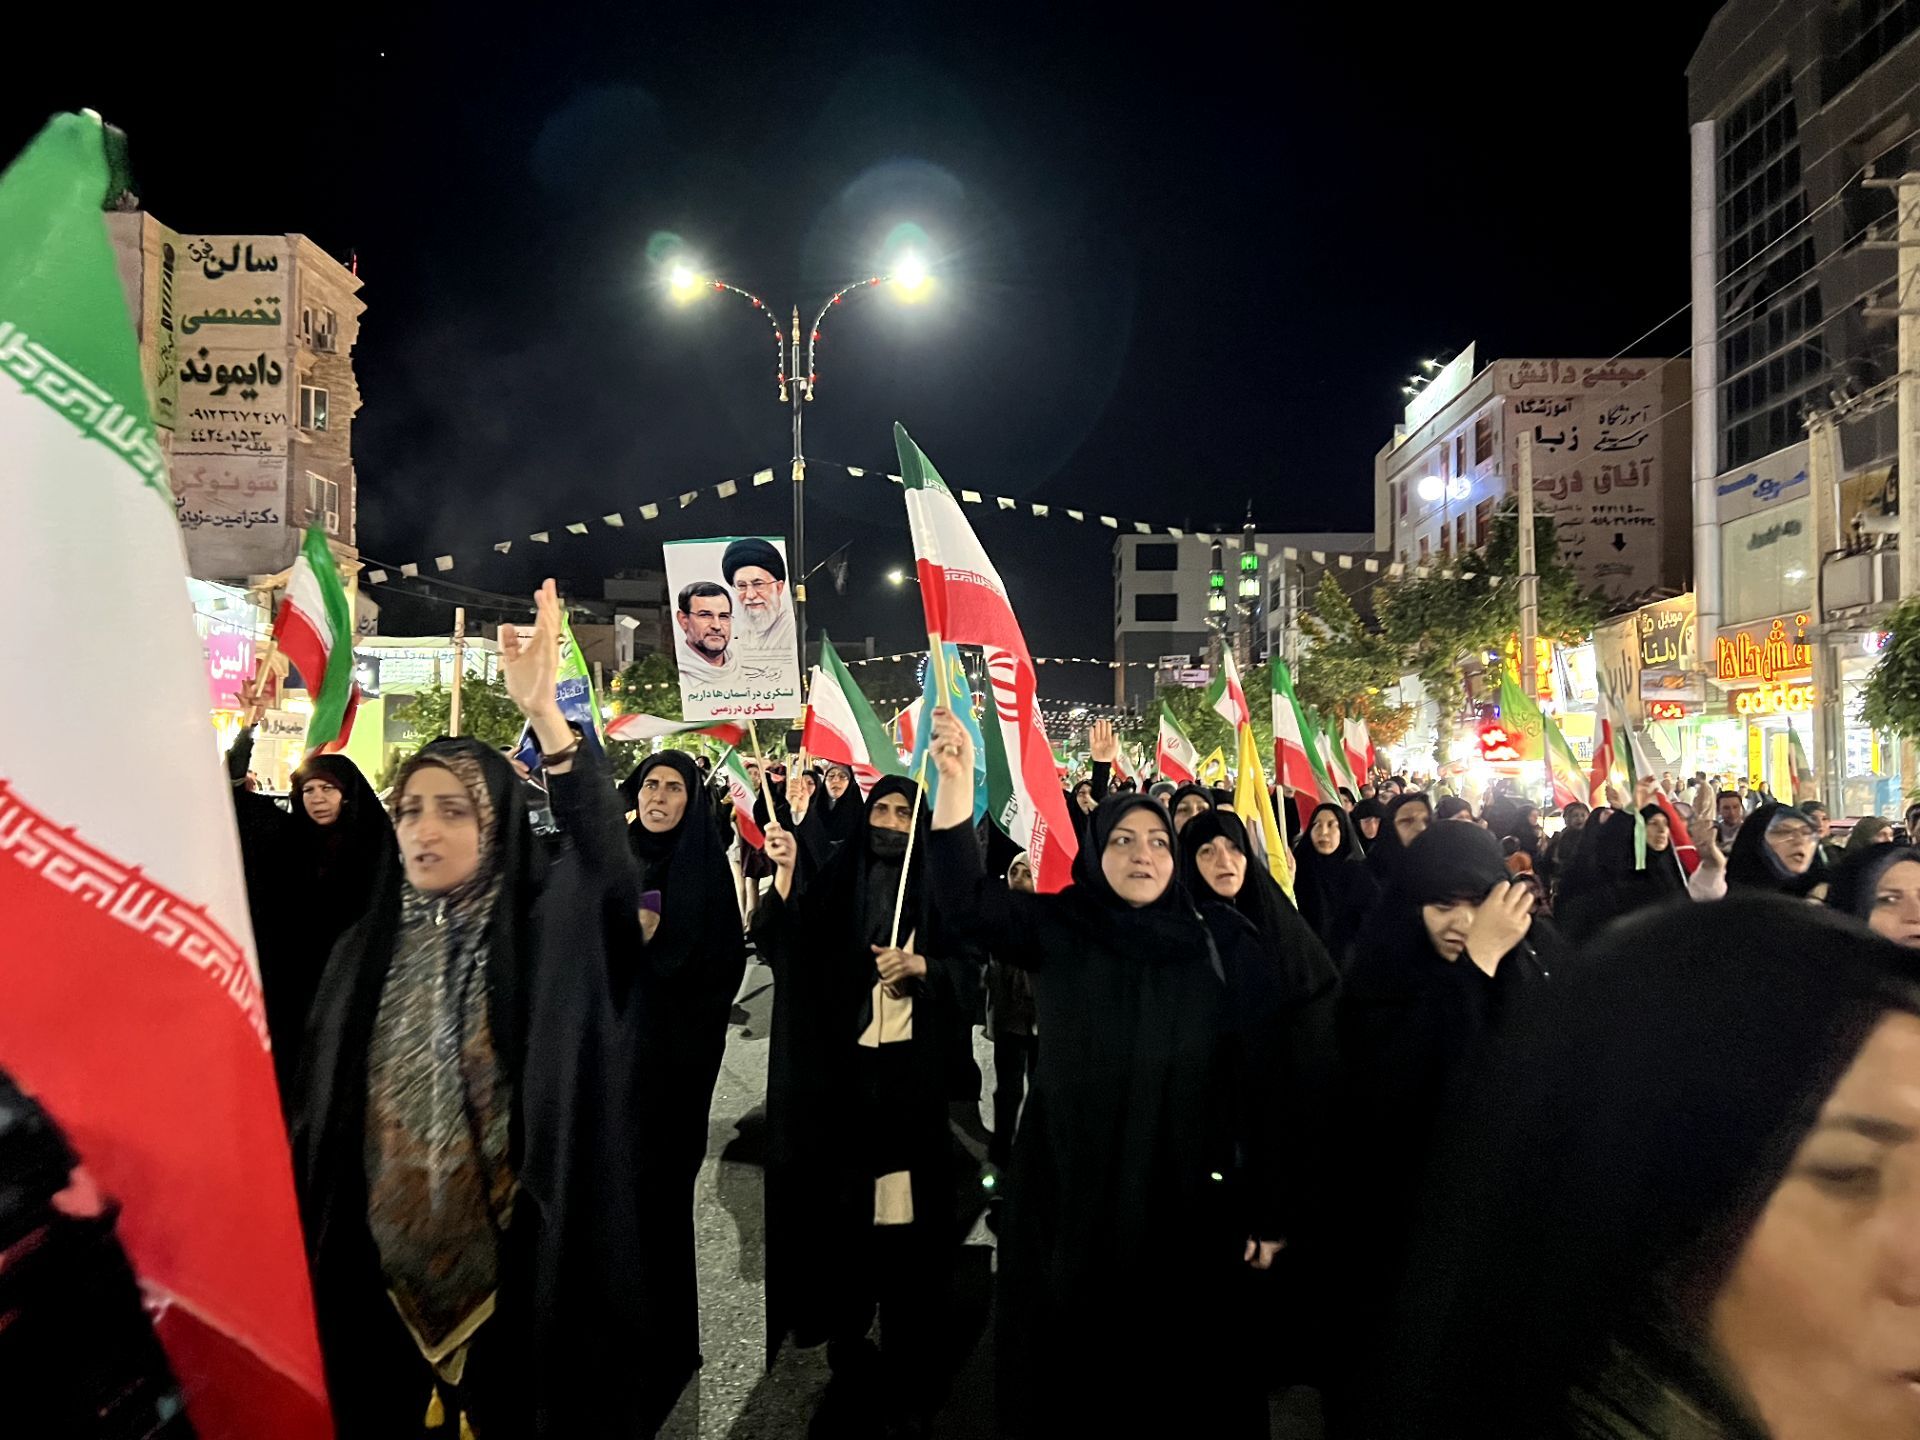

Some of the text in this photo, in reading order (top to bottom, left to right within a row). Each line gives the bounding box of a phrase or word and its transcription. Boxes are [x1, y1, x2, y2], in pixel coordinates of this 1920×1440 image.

[187, 238, 279, 280] سالن فوق
[180, 296, 282, 335] تخصصی
[180, 347, 283, 398] دایموند
[1509, 358, 1647, 390] مجتمع دانش
[1514, 397, 1574, 417] آموزشگاه
[1598, 403, 1651, 426] آموزشگاه
[245, 442, 272, 454] طبقه
[1515, 425, 1579, 452] زبا
[1593, 430, 1649, 452] موسیقی
[1593, 457, 1654, 495] آفاق
[244, 507, 279, 529] دکتر
[1657, 610, 1683, 631] موبایل
[419, 649, 473, 664] داوخانه
[1643, 636, 1678, 665] دلتا
[688, 689, 711, 701] داریم
[752, 689, 761, 700] در
[763, 687, 794, 700] لشکری
[1735, 682, 1818, 717] adidas
[711, 702, 775, 716] لشکری در زمین
